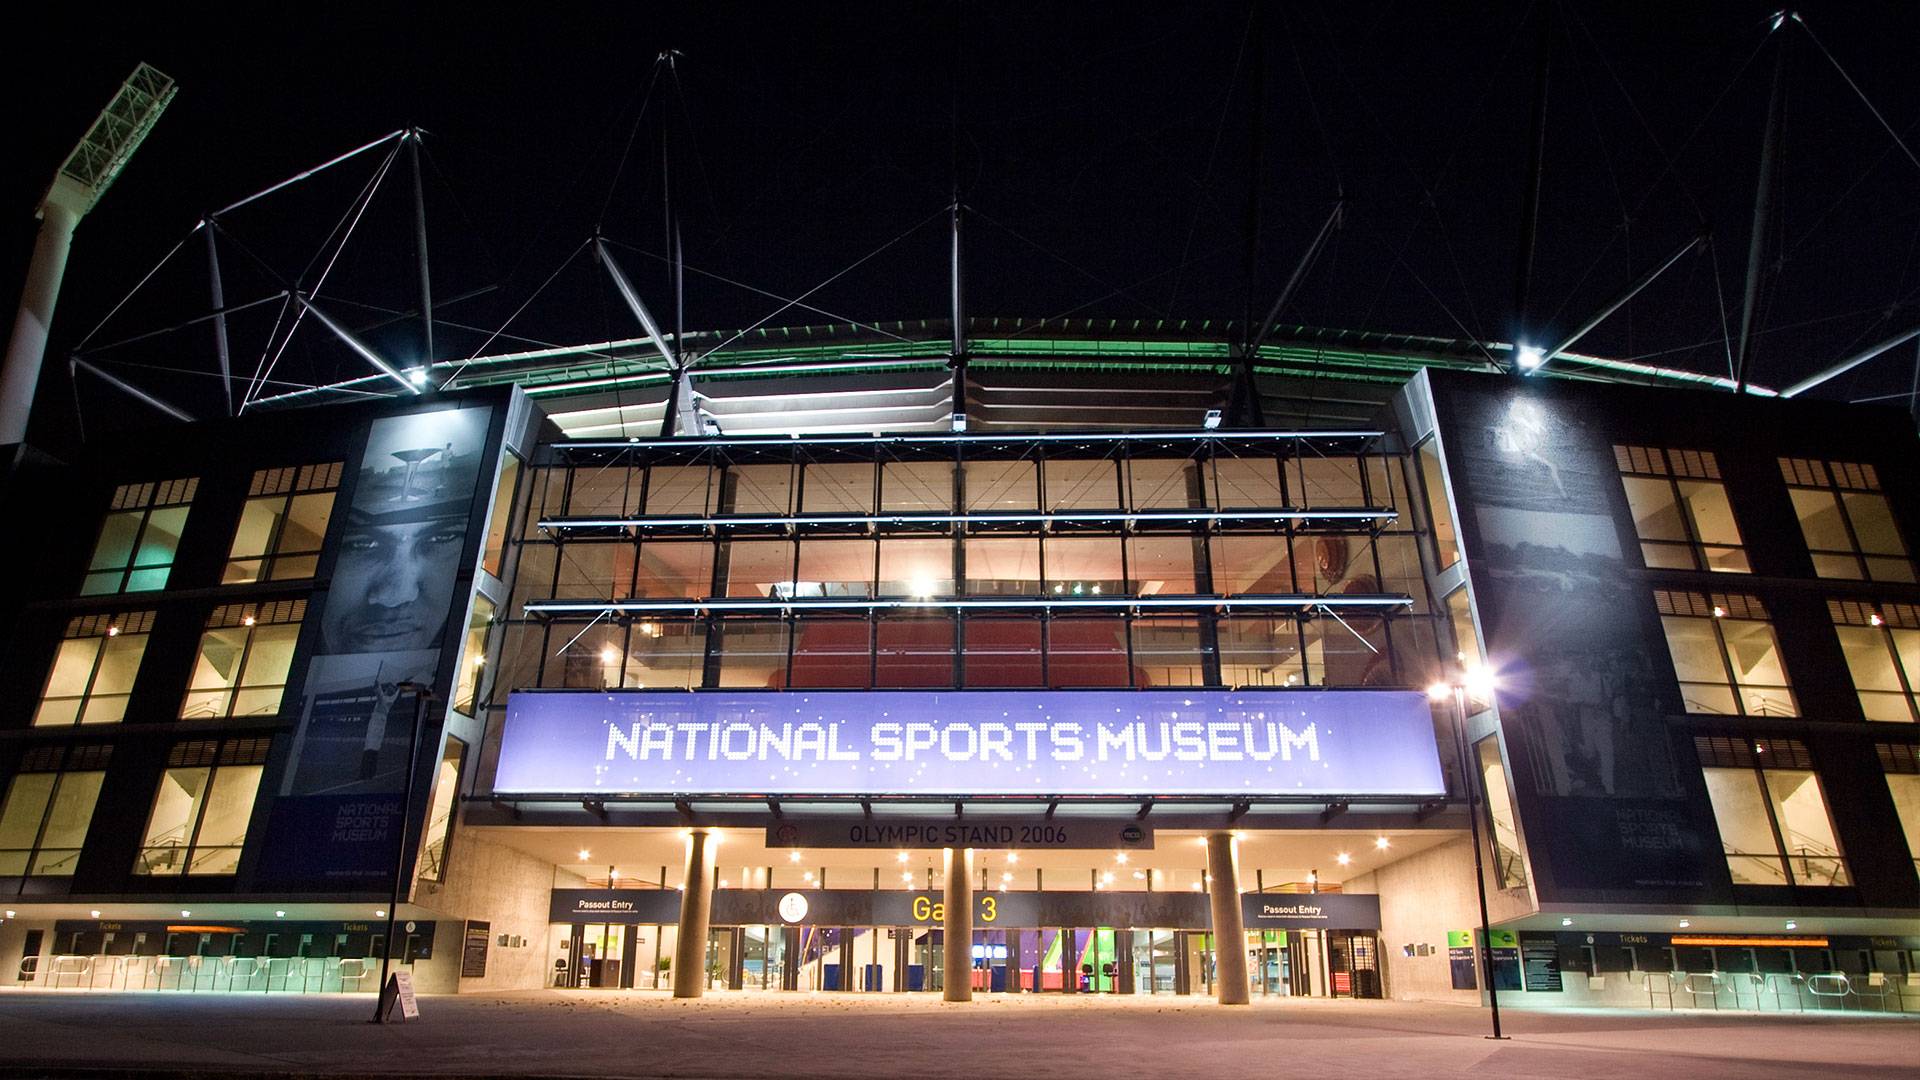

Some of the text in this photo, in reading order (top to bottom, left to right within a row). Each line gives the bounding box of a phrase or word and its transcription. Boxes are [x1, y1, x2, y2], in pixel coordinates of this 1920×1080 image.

[606, 722, 1320, 761] NATIONAL SPORTS MUSEUM
[338, 803, 402, 816] NATIONAL
[335, 816, 389, 829] SPORTS
[332, 829, 388, 842] MUSEUM
[850, 826, 1067, 843] OLYMPIC STAND 2006
[578, 900, 634, 910] Passout Entry
[913, 896, 997, 921] Ga 3
[1263, 905, 1322, 916] Passout Entry
[99, 922, 122, 930] Tickets
[343, 922, 369, 932] Tickets
[1619, 934, 1648, 943] Tickets
